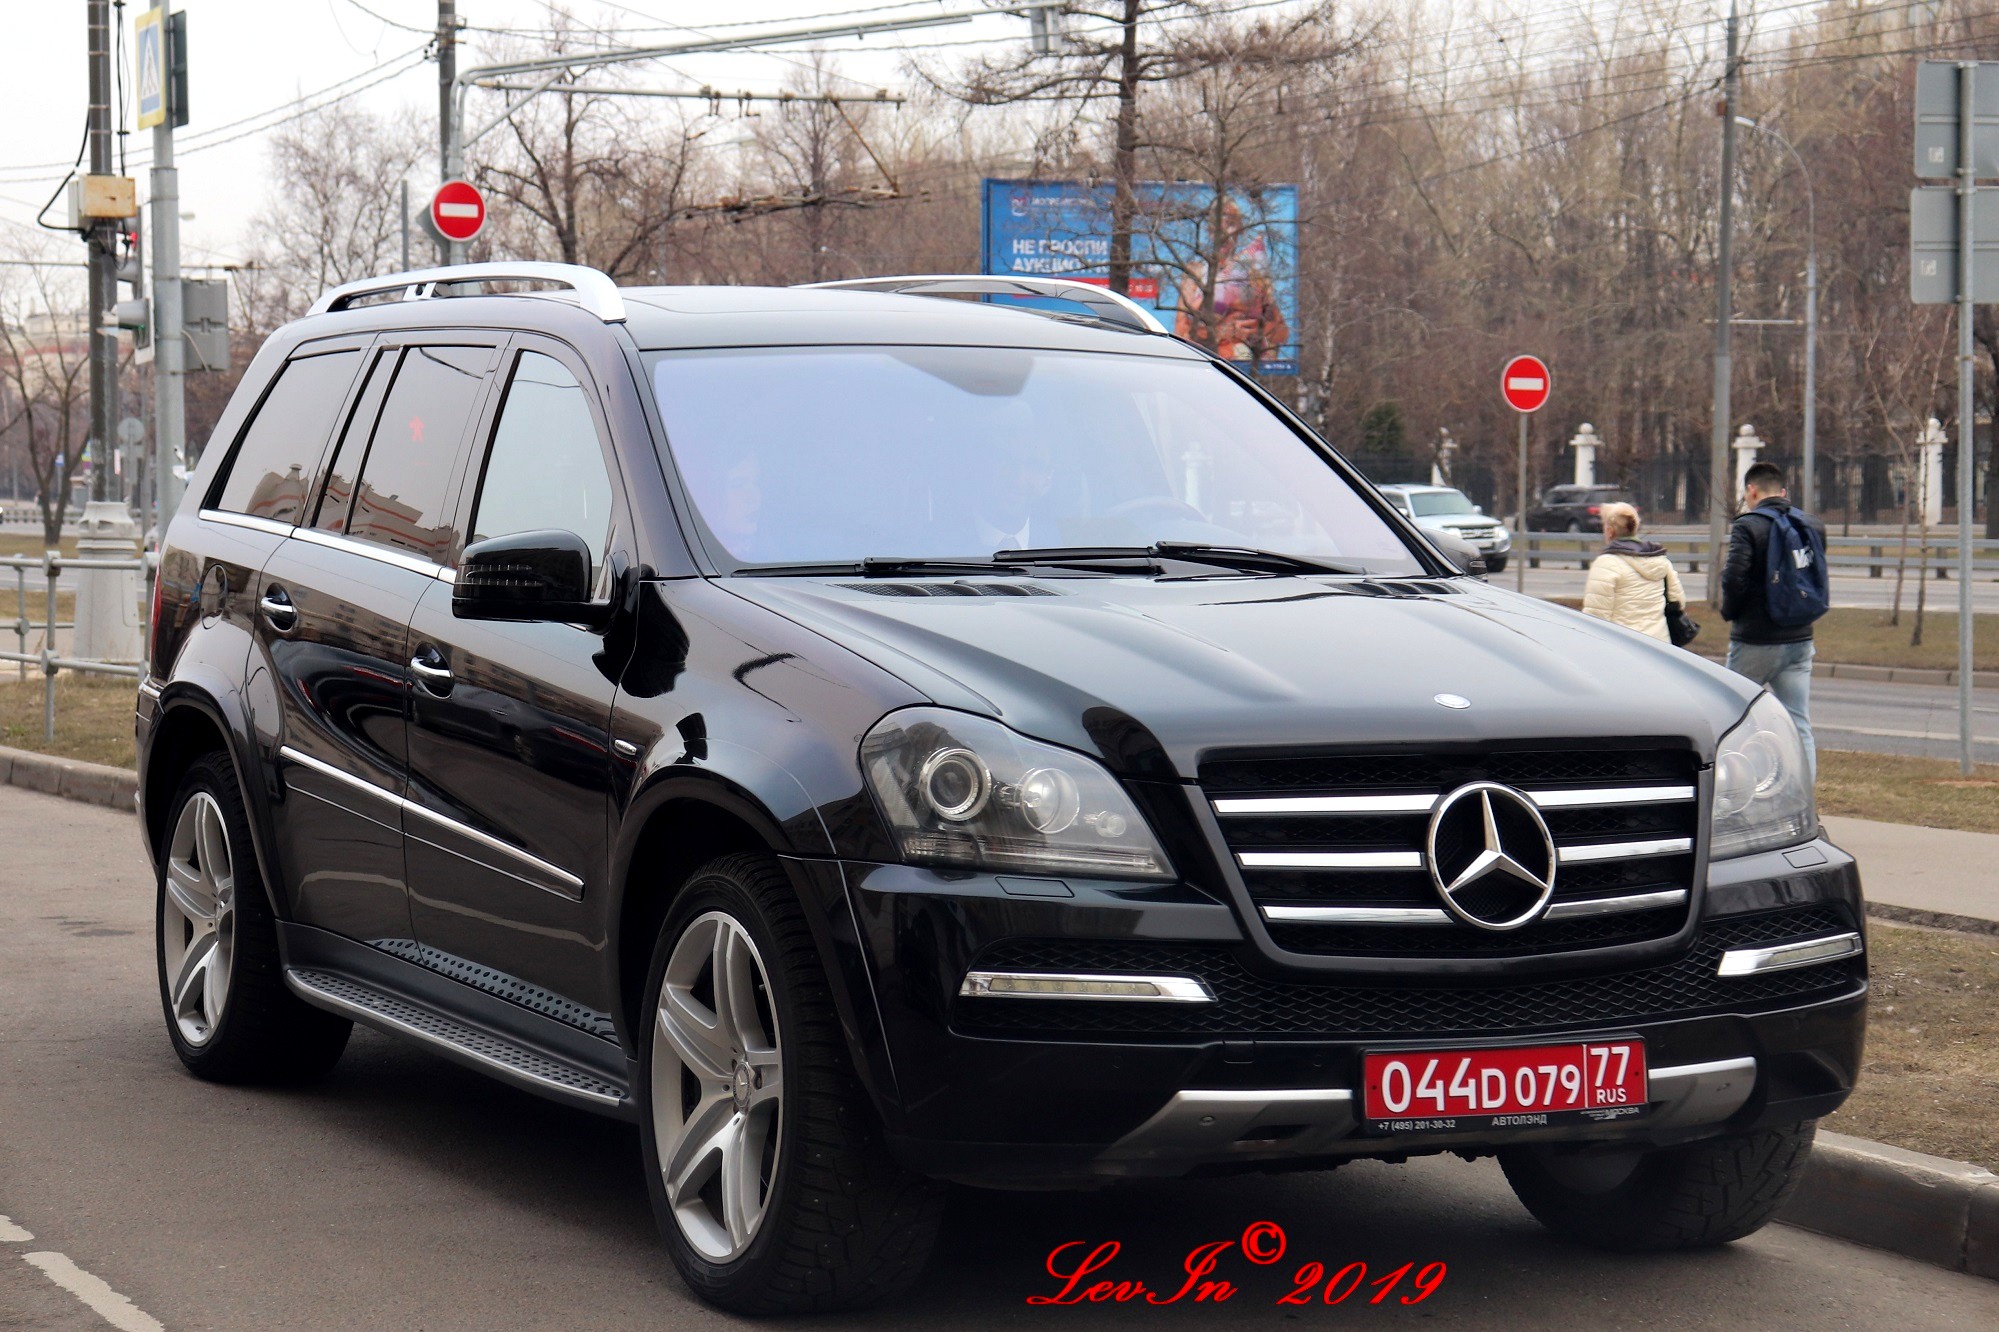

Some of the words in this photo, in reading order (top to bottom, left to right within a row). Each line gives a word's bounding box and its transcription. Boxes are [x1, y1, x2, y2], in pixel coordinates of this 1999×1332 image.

[1012, 239, 1035, 255] НЕ
[1038, 239, 1107, 256] ПРОСПИ
[1590, 1045, 1631, 1088] 77
[1596, 1088, 1627, 1104] RUS
[1377, 1121, 1390, 1131] +7
[1391, 1120, 1413, 1132] (495)
[1491, 1114, 1548, 1126] АВТОЛЭНД
